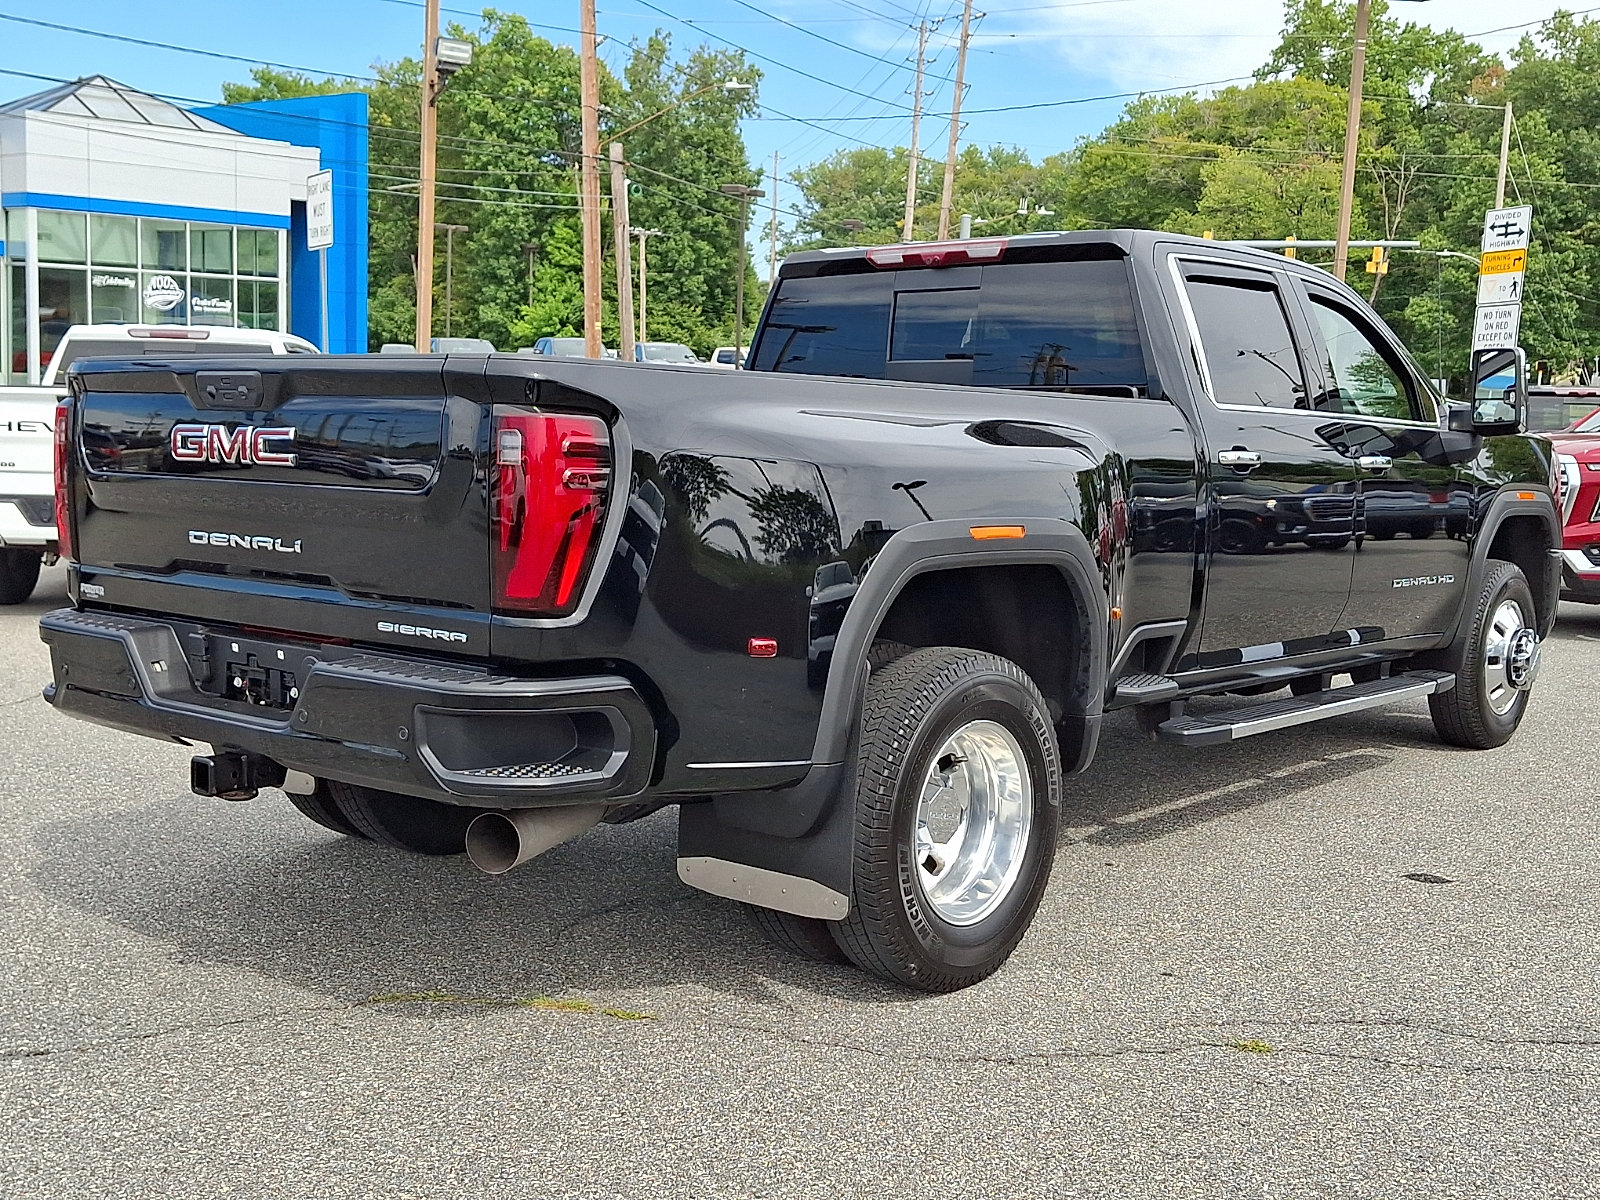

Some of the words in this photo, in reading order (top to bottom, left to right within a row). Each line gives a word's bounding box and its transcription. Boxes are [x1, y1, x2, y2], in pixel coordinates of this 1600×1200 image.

[319, 180, 331, 193] LANE
[312, 203, 326, 217] MUST
[1494, 211, 1522, 221] DIVIDED
[309, 226, 319, 239] TURN
[320, 224, 332, 237] RIGHT
[1489, 238, 1521, 248] HIGHWAY
[1485, 254, 1511, 263] TURNING
[1484, 264, 1511, 272] VEHICLES
[1483, 311, 1493, 320] NO
[1495, 310, 1512, 319] TURN
[1484, 322, 1494, 330] ON
[1495, 321, 1509, 330] RED
[1477, 332, 1502, 342] EXCEPT
[1503, 332, 1513, 340] ON
[171, 423, 298, 467] GMC
[188, 530, 302, 553] DENALI
[1392, 576, 1437, 588] DENALI
[1437, 574, 1455, 584] HD
[377, 621, 469, 643] SIERRA
[1033, 716, 1058, 801] MICHELIN
[899, 849, 931, 941] MICHELIN
